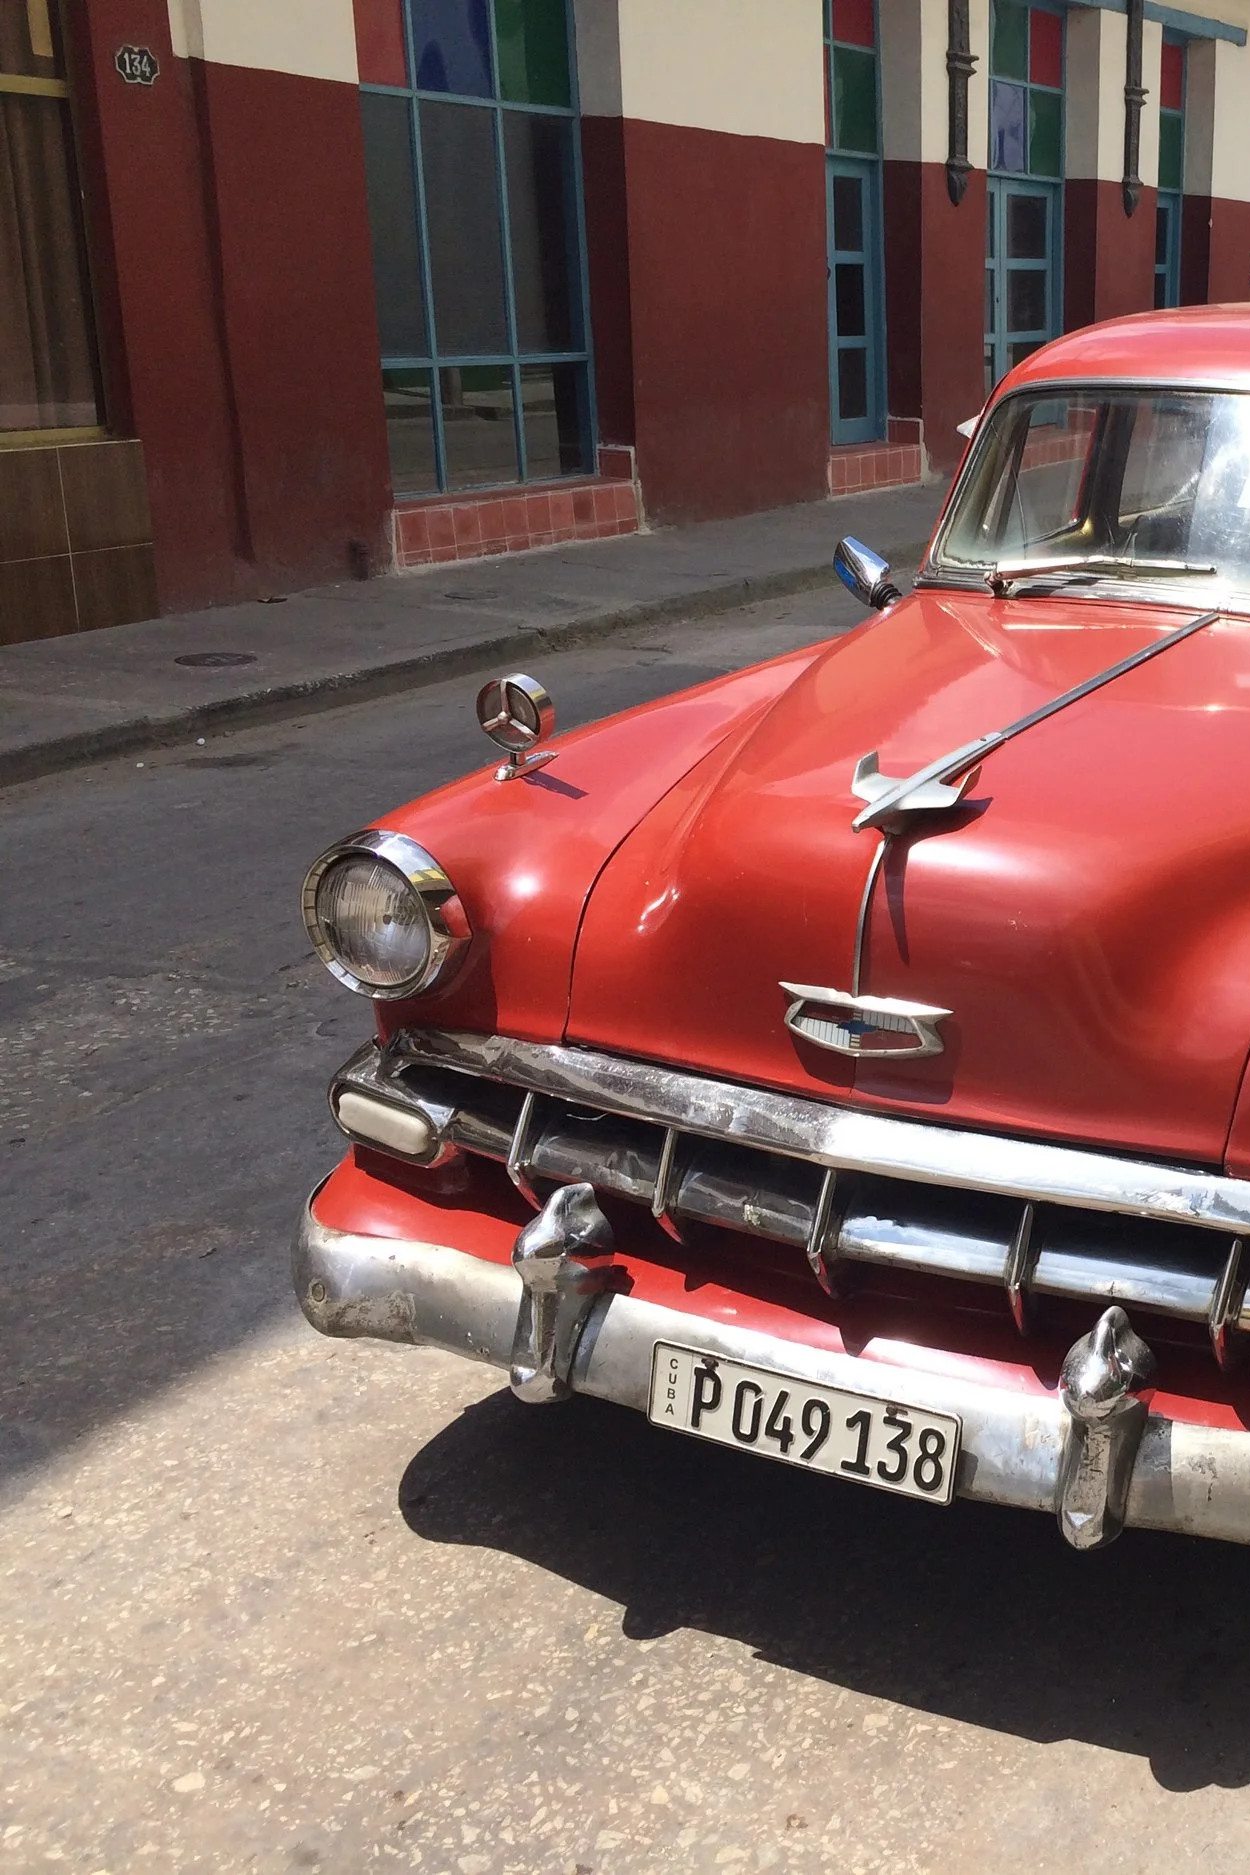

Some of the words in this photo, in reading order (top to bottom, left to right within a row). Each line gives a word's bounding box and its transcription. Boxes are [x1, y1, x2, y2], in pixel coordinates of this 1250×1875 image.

[123, 52, 151, 77] 134
[664, 1357, 679, 1416] CUBA
[731, 1380, 832, 1460] 049
[840, 1410, 946, 1491] 138
